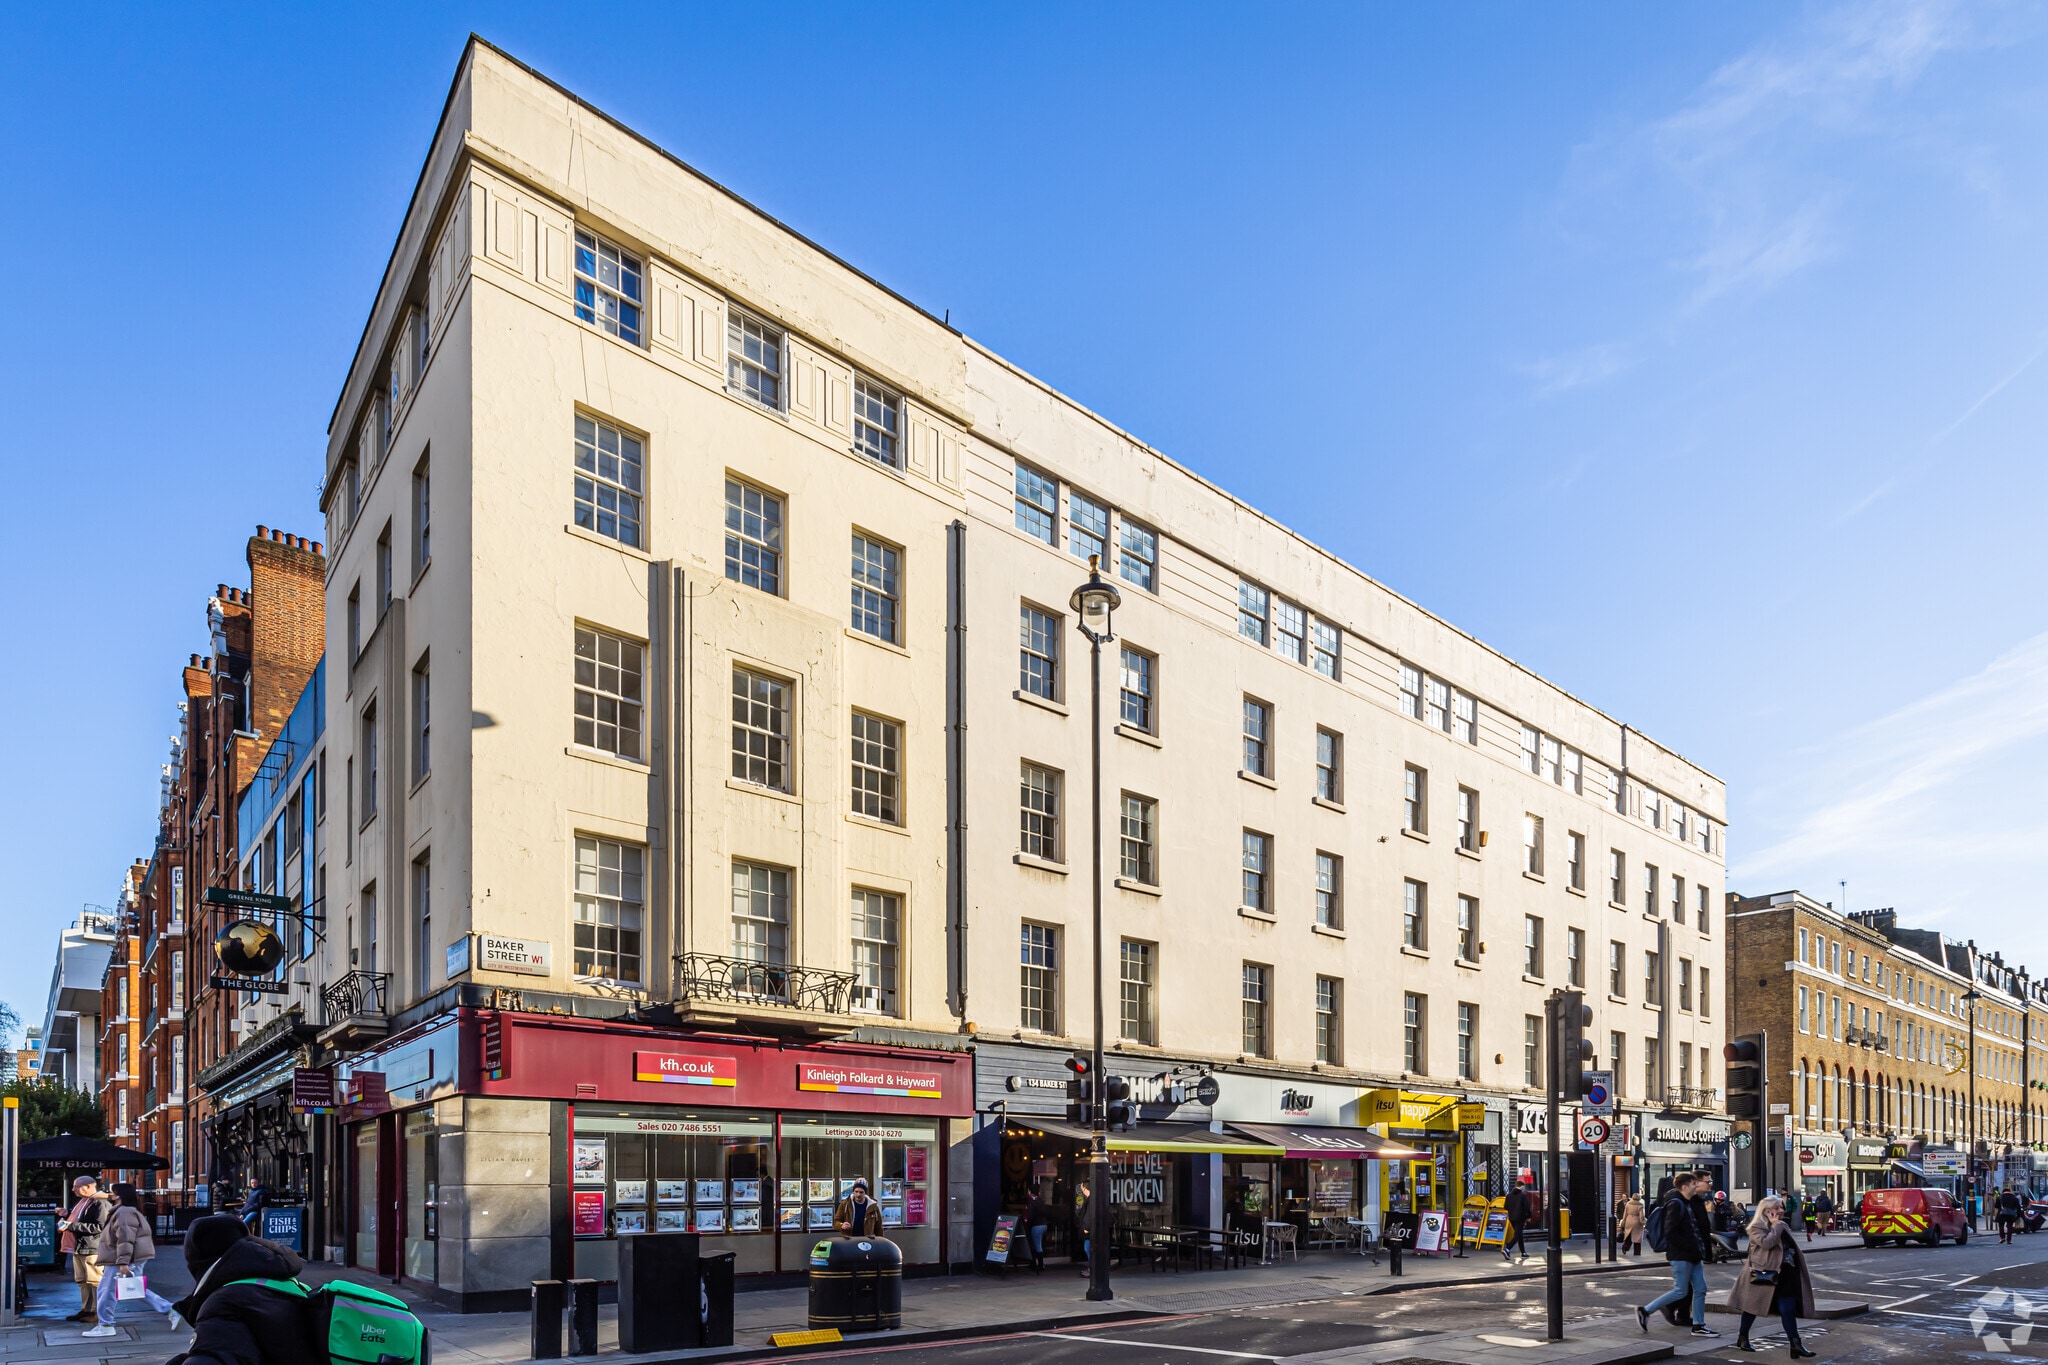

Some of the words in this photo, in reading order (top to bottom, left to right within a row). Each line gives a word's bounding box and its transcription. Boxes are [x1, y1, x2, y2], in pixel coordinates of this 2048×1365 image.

[228, 893, 254, 902] GREENE
[487, 939, 524, 951] BAKER
[487, 950, 529, 962] STREET
[531, 954, 543, 965] W1
[504, 964, 533, 972] WESTMINSTER
[220, 979, 242, 988] THE
[244, 981, 280, 991] GLOBE
[659, 1058, 715, 1073] kfh.co.uk
[807, 1068, 847, 1084] Kinleigh
[849, 1072, 884, 1085] Folkard
[886, 1074, 894, 1085] &
[896, 1075, 935, 1089] Hayward
[1039, 1080, 1058, 1088] BAKER
[295, 1098, 332, 1107] kfh.co.uk
[1284, 1088, 1314, 1110] itsu
[1376, 1100, 1395, 1110] itsu
[637, 1122, 659, 1131] Sales
[661, 1123, 677, 1131] 020
[680, 1123, 700, 1132] 7486
[702, 1124, 722, 1132] 5551
[825, 1128, 852, 1138] Lettings
[854, 1129, 867, 1137] 020
[868, 1129, 885, 1137] 3040
[886, 1130, 902, 1138] 6270
[1584, 1125, 1602, 1137] 20
[1291, 1132, 1366, 1149] itsu
[1657, 1128, 1697, 1141] STARBUCKS
[1698, 1130, 1722, 1143] COFFEE
[37, 1160, 62, 1168] THE
[66, 1160, 106, 1168] GLOBE
[1133, 1154, 1163, 1174] LEVEL
[269, 1217, 291, 1225] FISH
[269, 1225, 297, 1234] CHIPS
[1234, 1227, 1260, 1245] itsu
[361, 1323, 387, 1335] Uber
[360, 1333, 385, 1343] Eats
